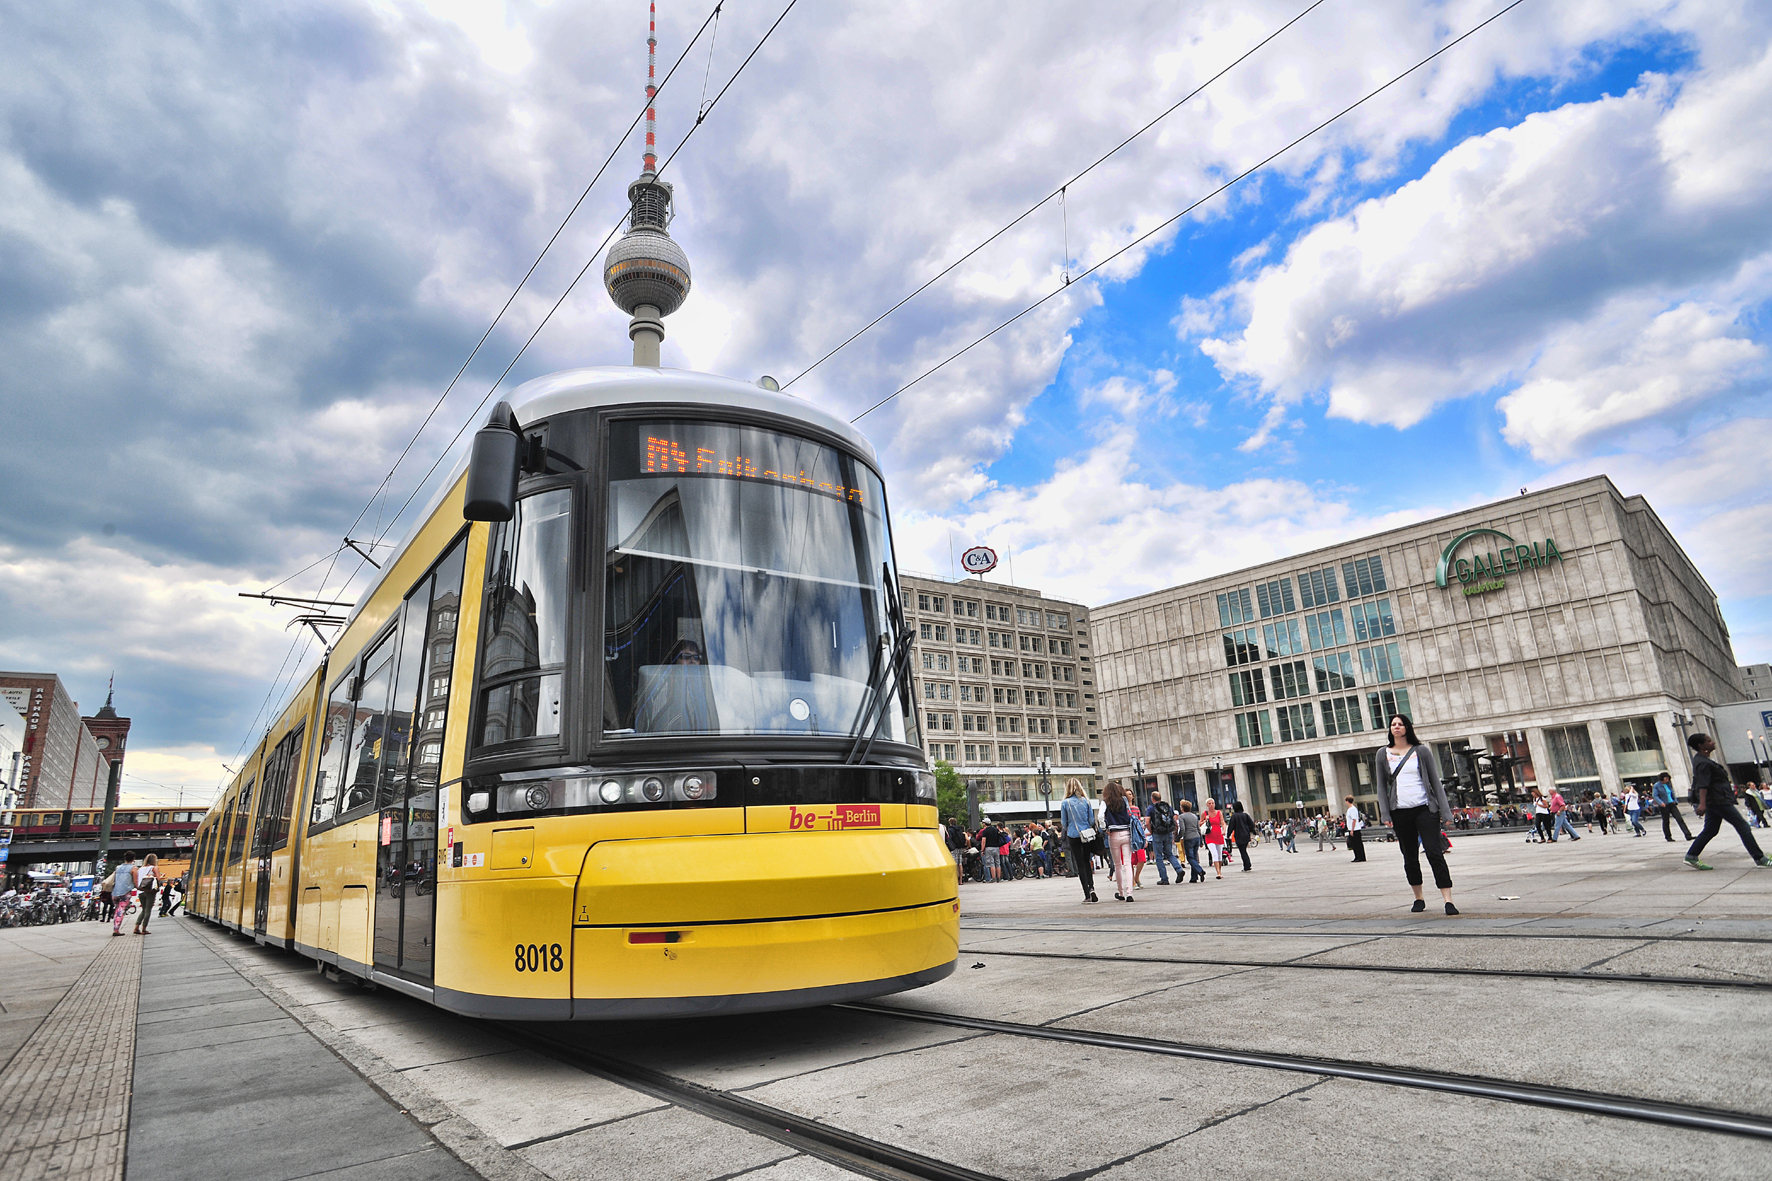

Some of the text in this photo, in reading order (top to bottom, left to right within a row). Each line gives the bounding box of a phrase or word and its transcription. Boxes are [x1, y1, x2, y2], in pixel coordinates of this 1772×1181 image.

[647, 436, 689, 473] M4
[967, 553, 991, 566] C&A
[1454, 538, 1563, 583] GALERIA
[29, 687, 44, 730] RATHAUS
[789, 806, 878, 829] be Berlin
[515, 943, 564, 973] 8018
